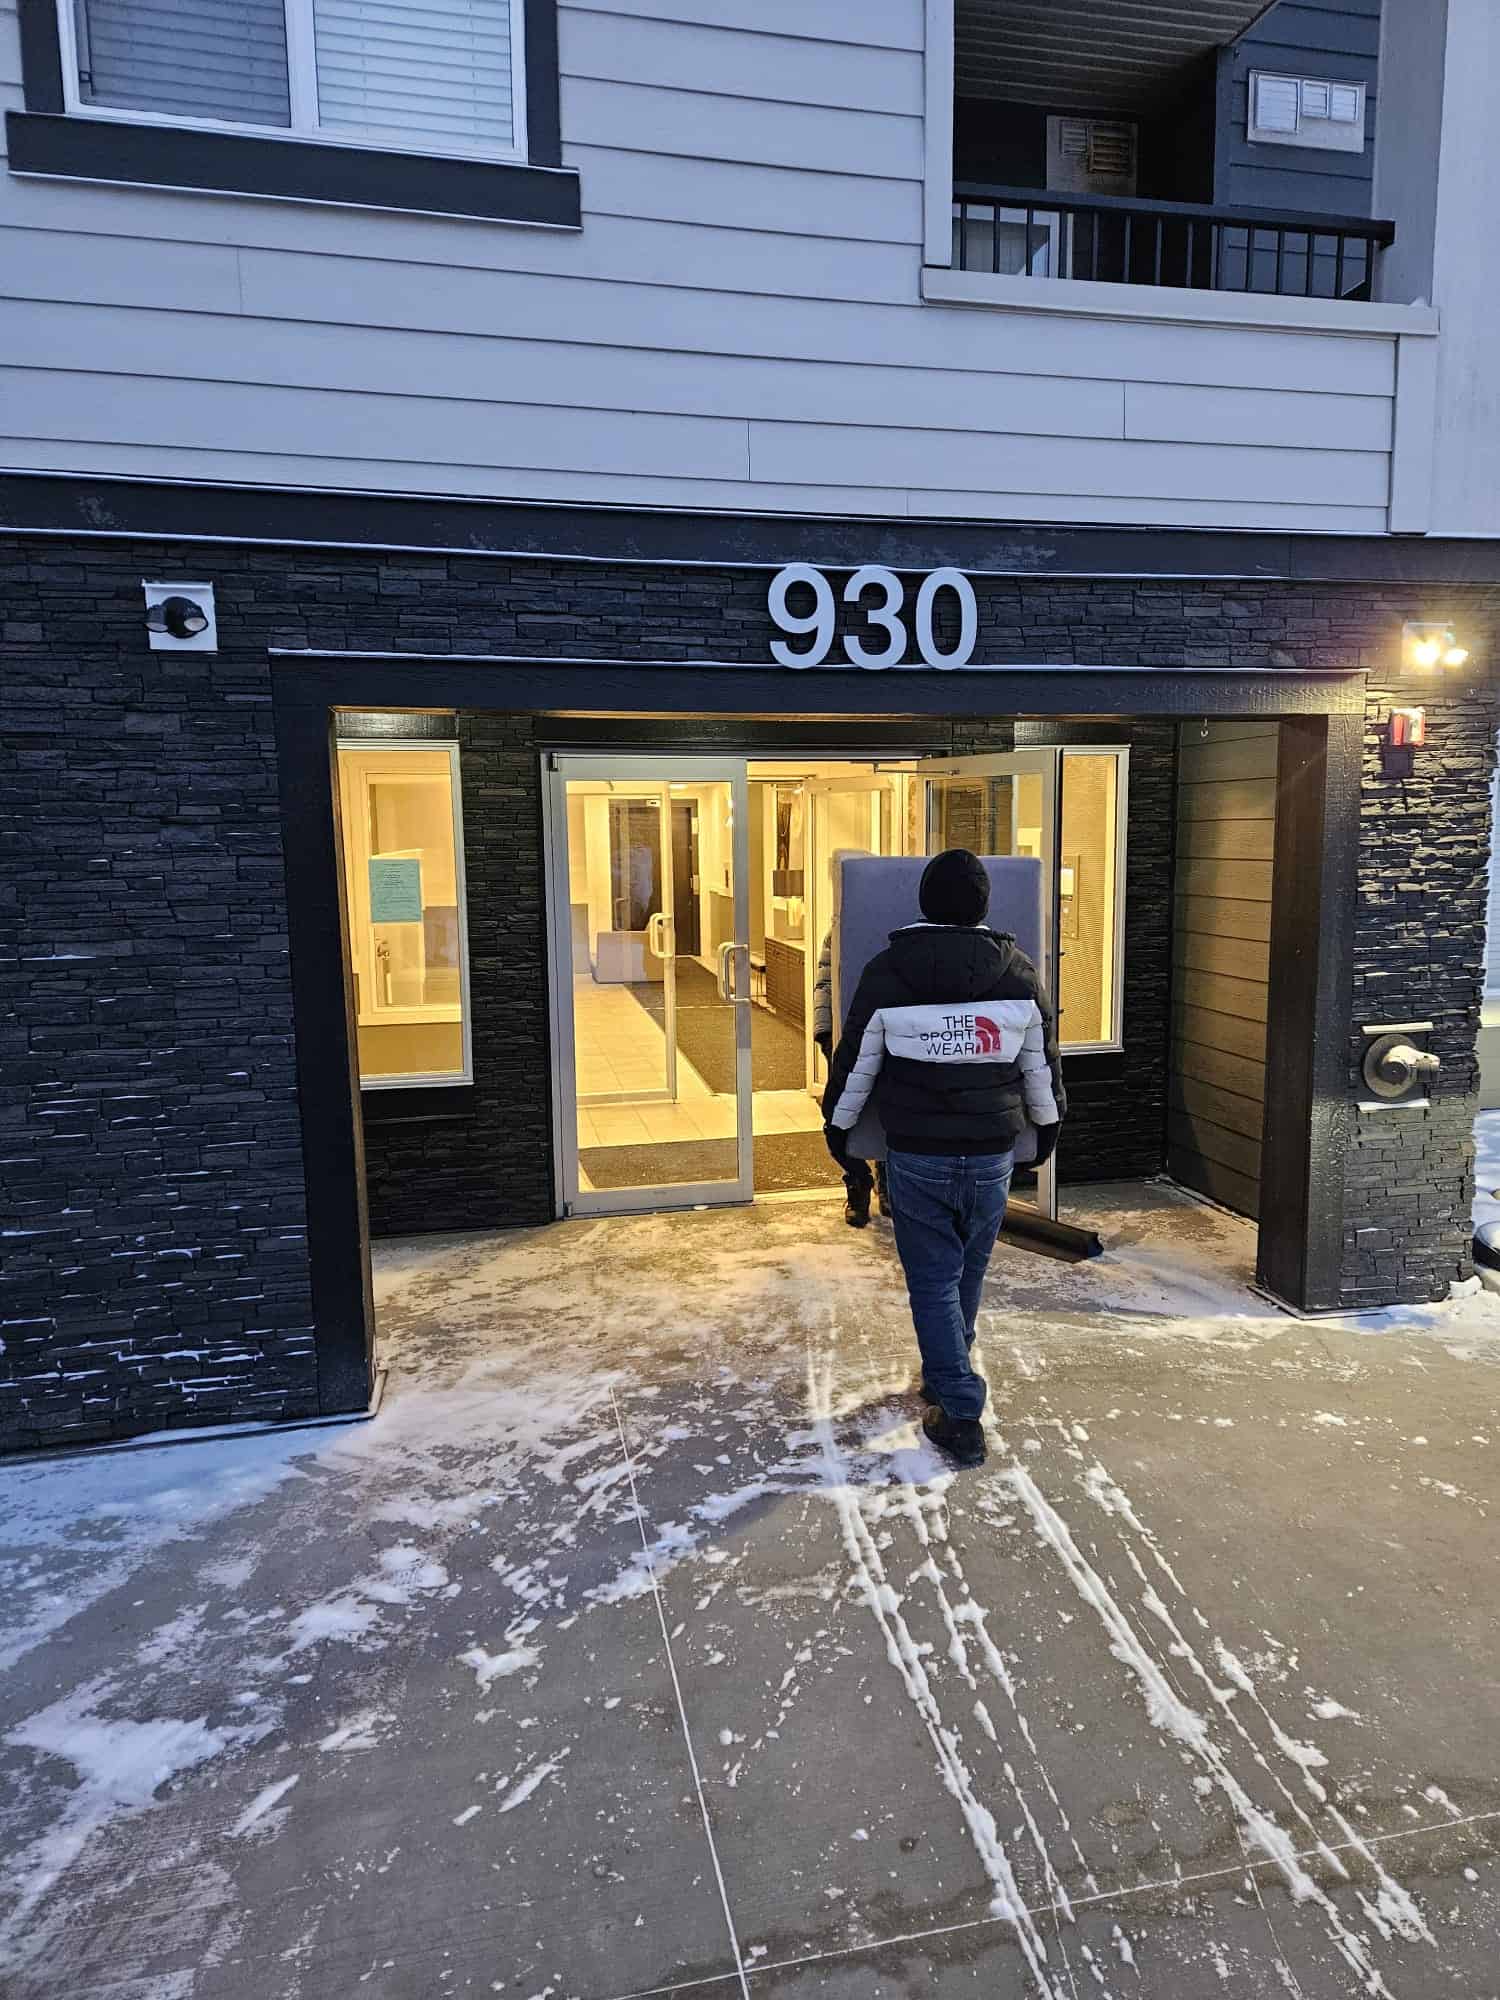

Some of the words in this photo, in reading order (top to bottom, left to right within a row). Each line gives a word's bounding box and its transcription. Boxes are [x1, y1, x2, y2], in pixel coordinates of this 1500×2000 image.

[768, 562, 977, 670] 930
[942, 1015, 974, 1029] THE
[927, 1042, 975, 1056] WEAR
